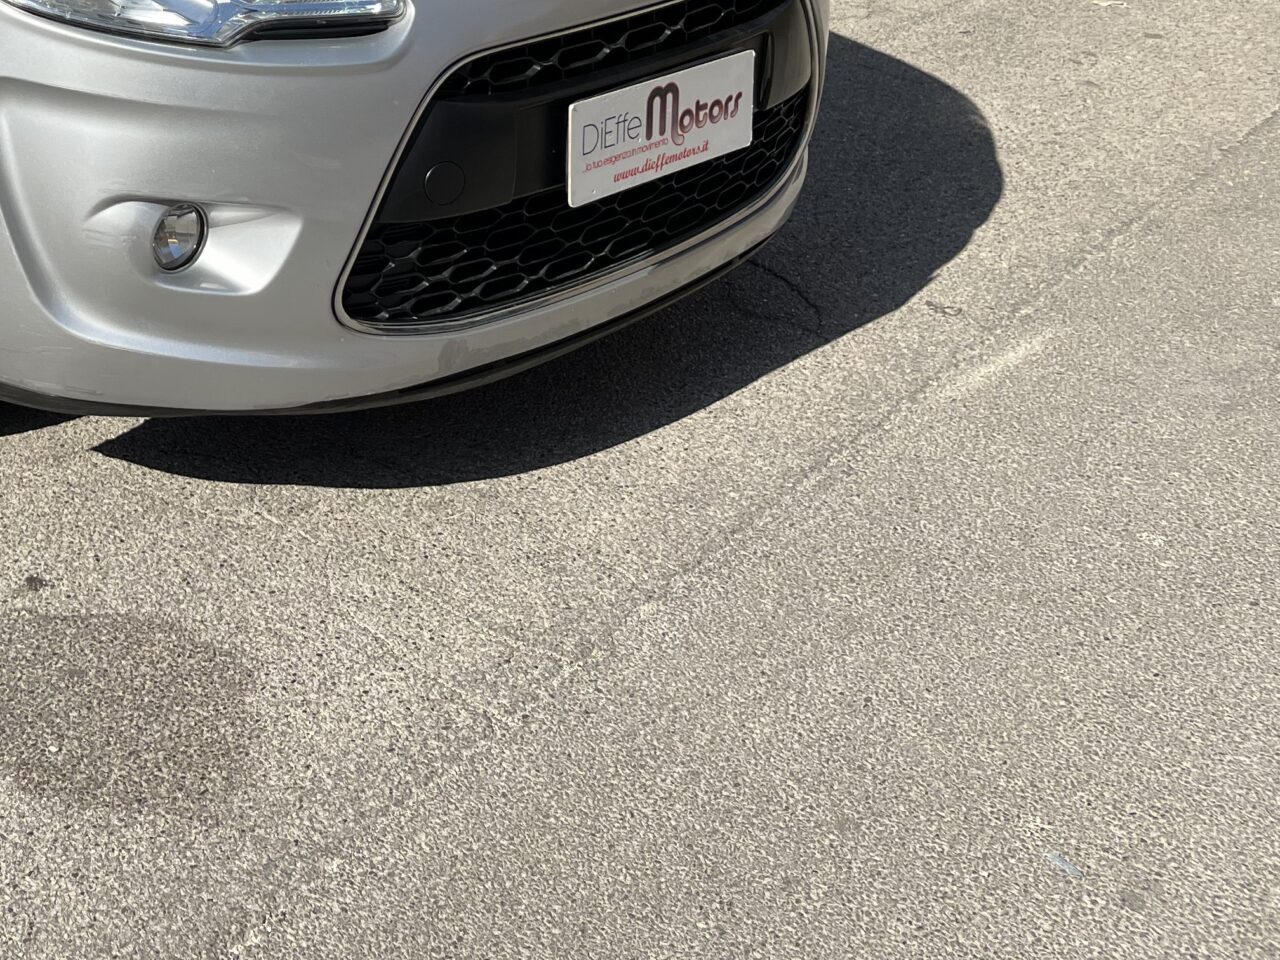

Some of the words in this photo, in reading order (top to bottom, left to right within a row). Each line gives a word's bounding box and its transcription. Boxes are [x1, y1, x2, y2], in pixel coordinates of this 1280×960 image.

[582, 112, 643, 156] DiEffe
[645, 81, 743, 146] Motors
[613, 139, 710, 183] www.dieffemotors.it
